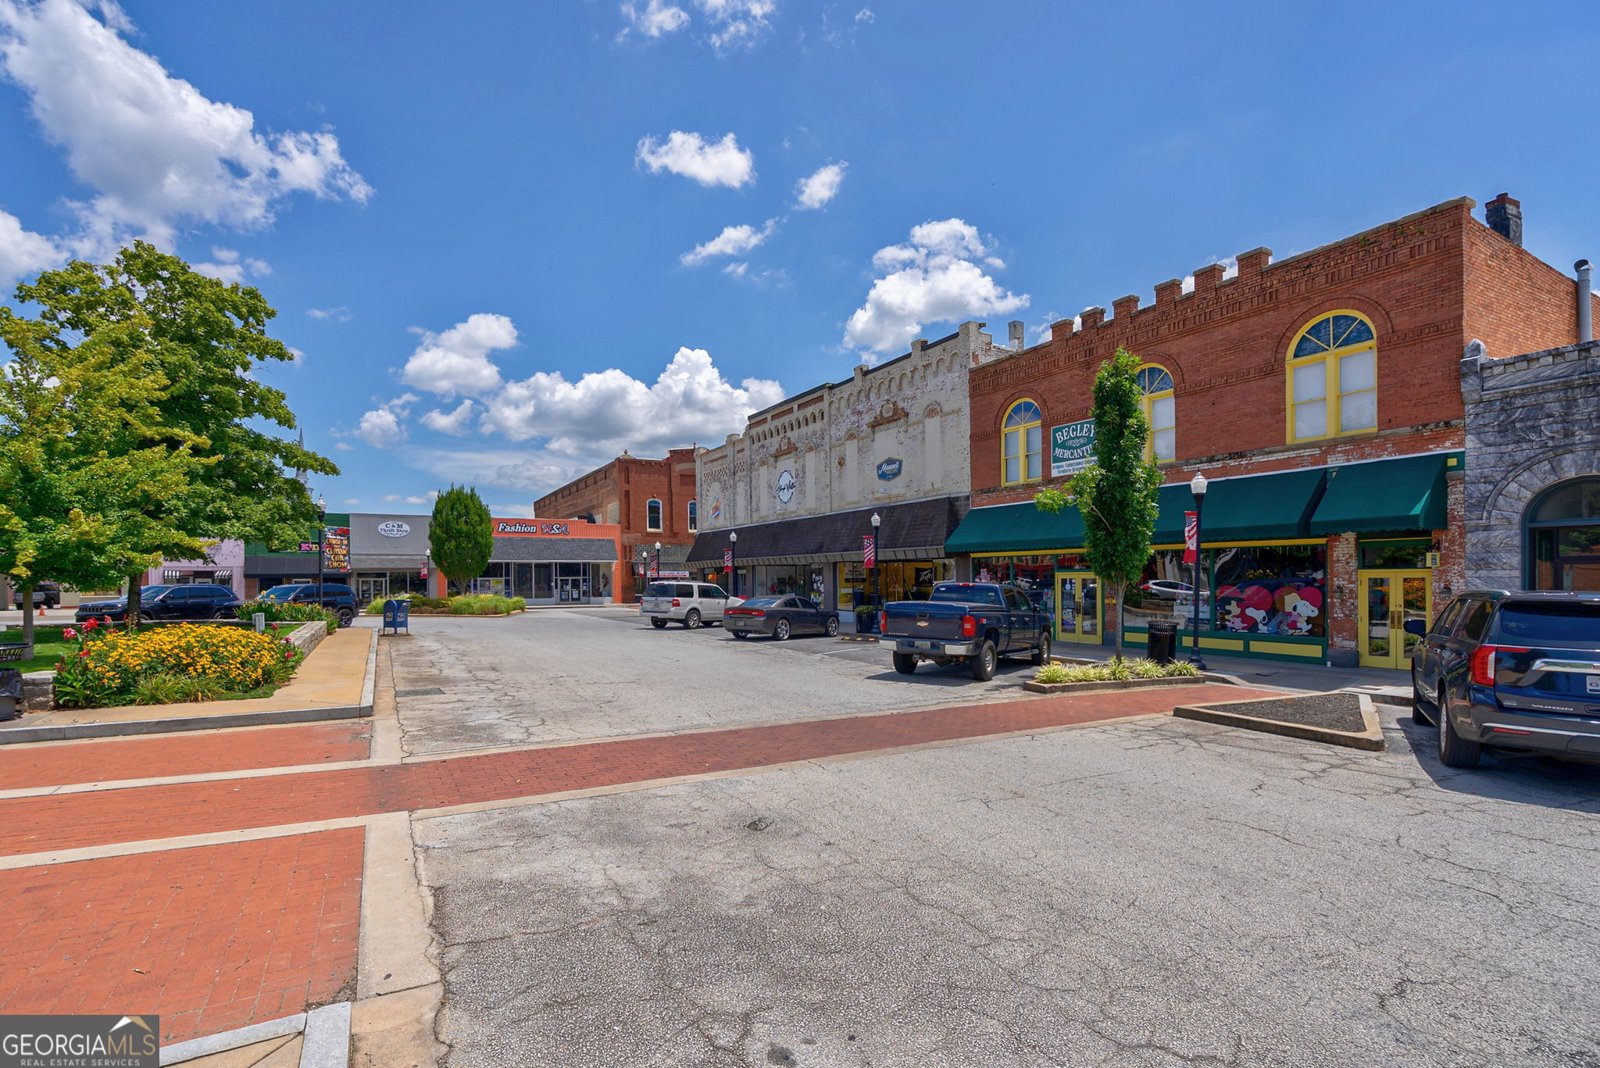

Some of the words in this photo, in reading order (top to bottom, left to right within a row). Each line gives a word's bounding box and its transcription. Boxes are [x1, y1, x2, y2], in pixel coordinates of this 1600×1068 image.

[1053, 444, 1093, 459] MERCANTI
[498, 522, 537, 533] Fashion
[541, 524, 569, 534] USA
